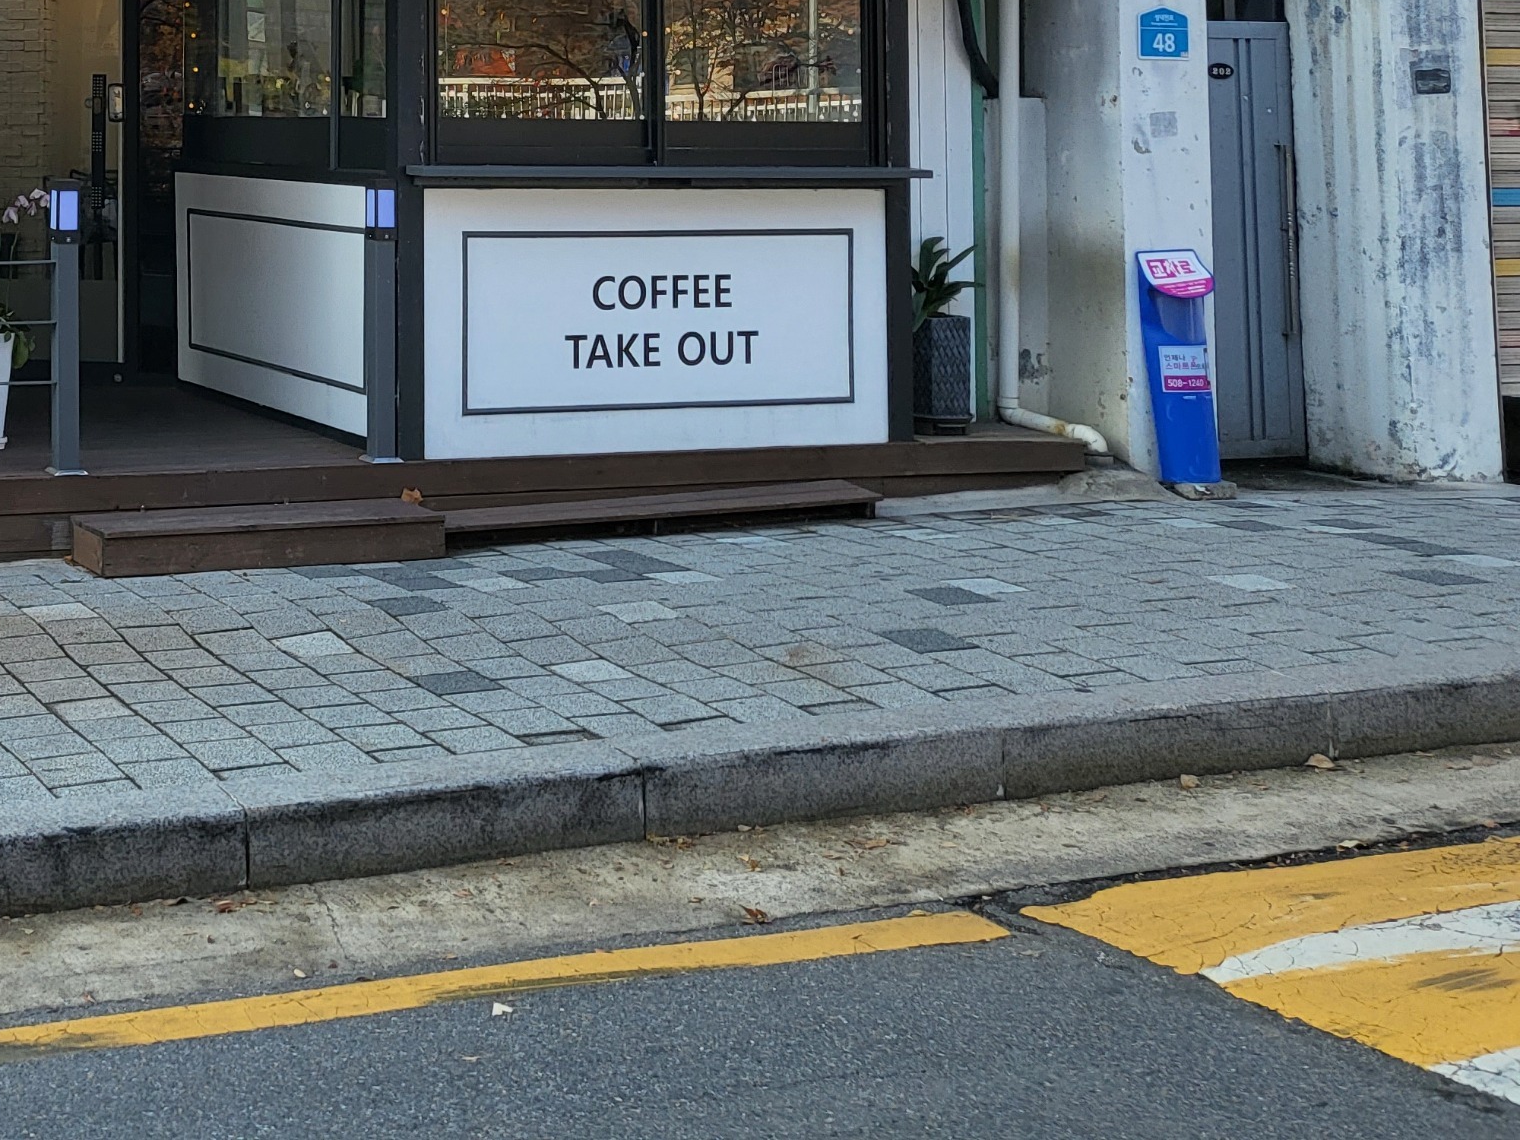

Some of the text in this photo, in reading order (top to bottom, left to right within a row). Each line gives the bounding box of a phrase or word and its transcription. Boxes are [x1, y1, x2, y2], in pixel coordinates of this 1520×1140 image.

[1152, 33, 1176, 53] 48
[1212, 67, 1232, 76] 202
[592, 274, 732, 310] COFFEE
[565, 331, 759, 369] TAKE OUT
[1167, 378, 1205, 388] 508-1240
